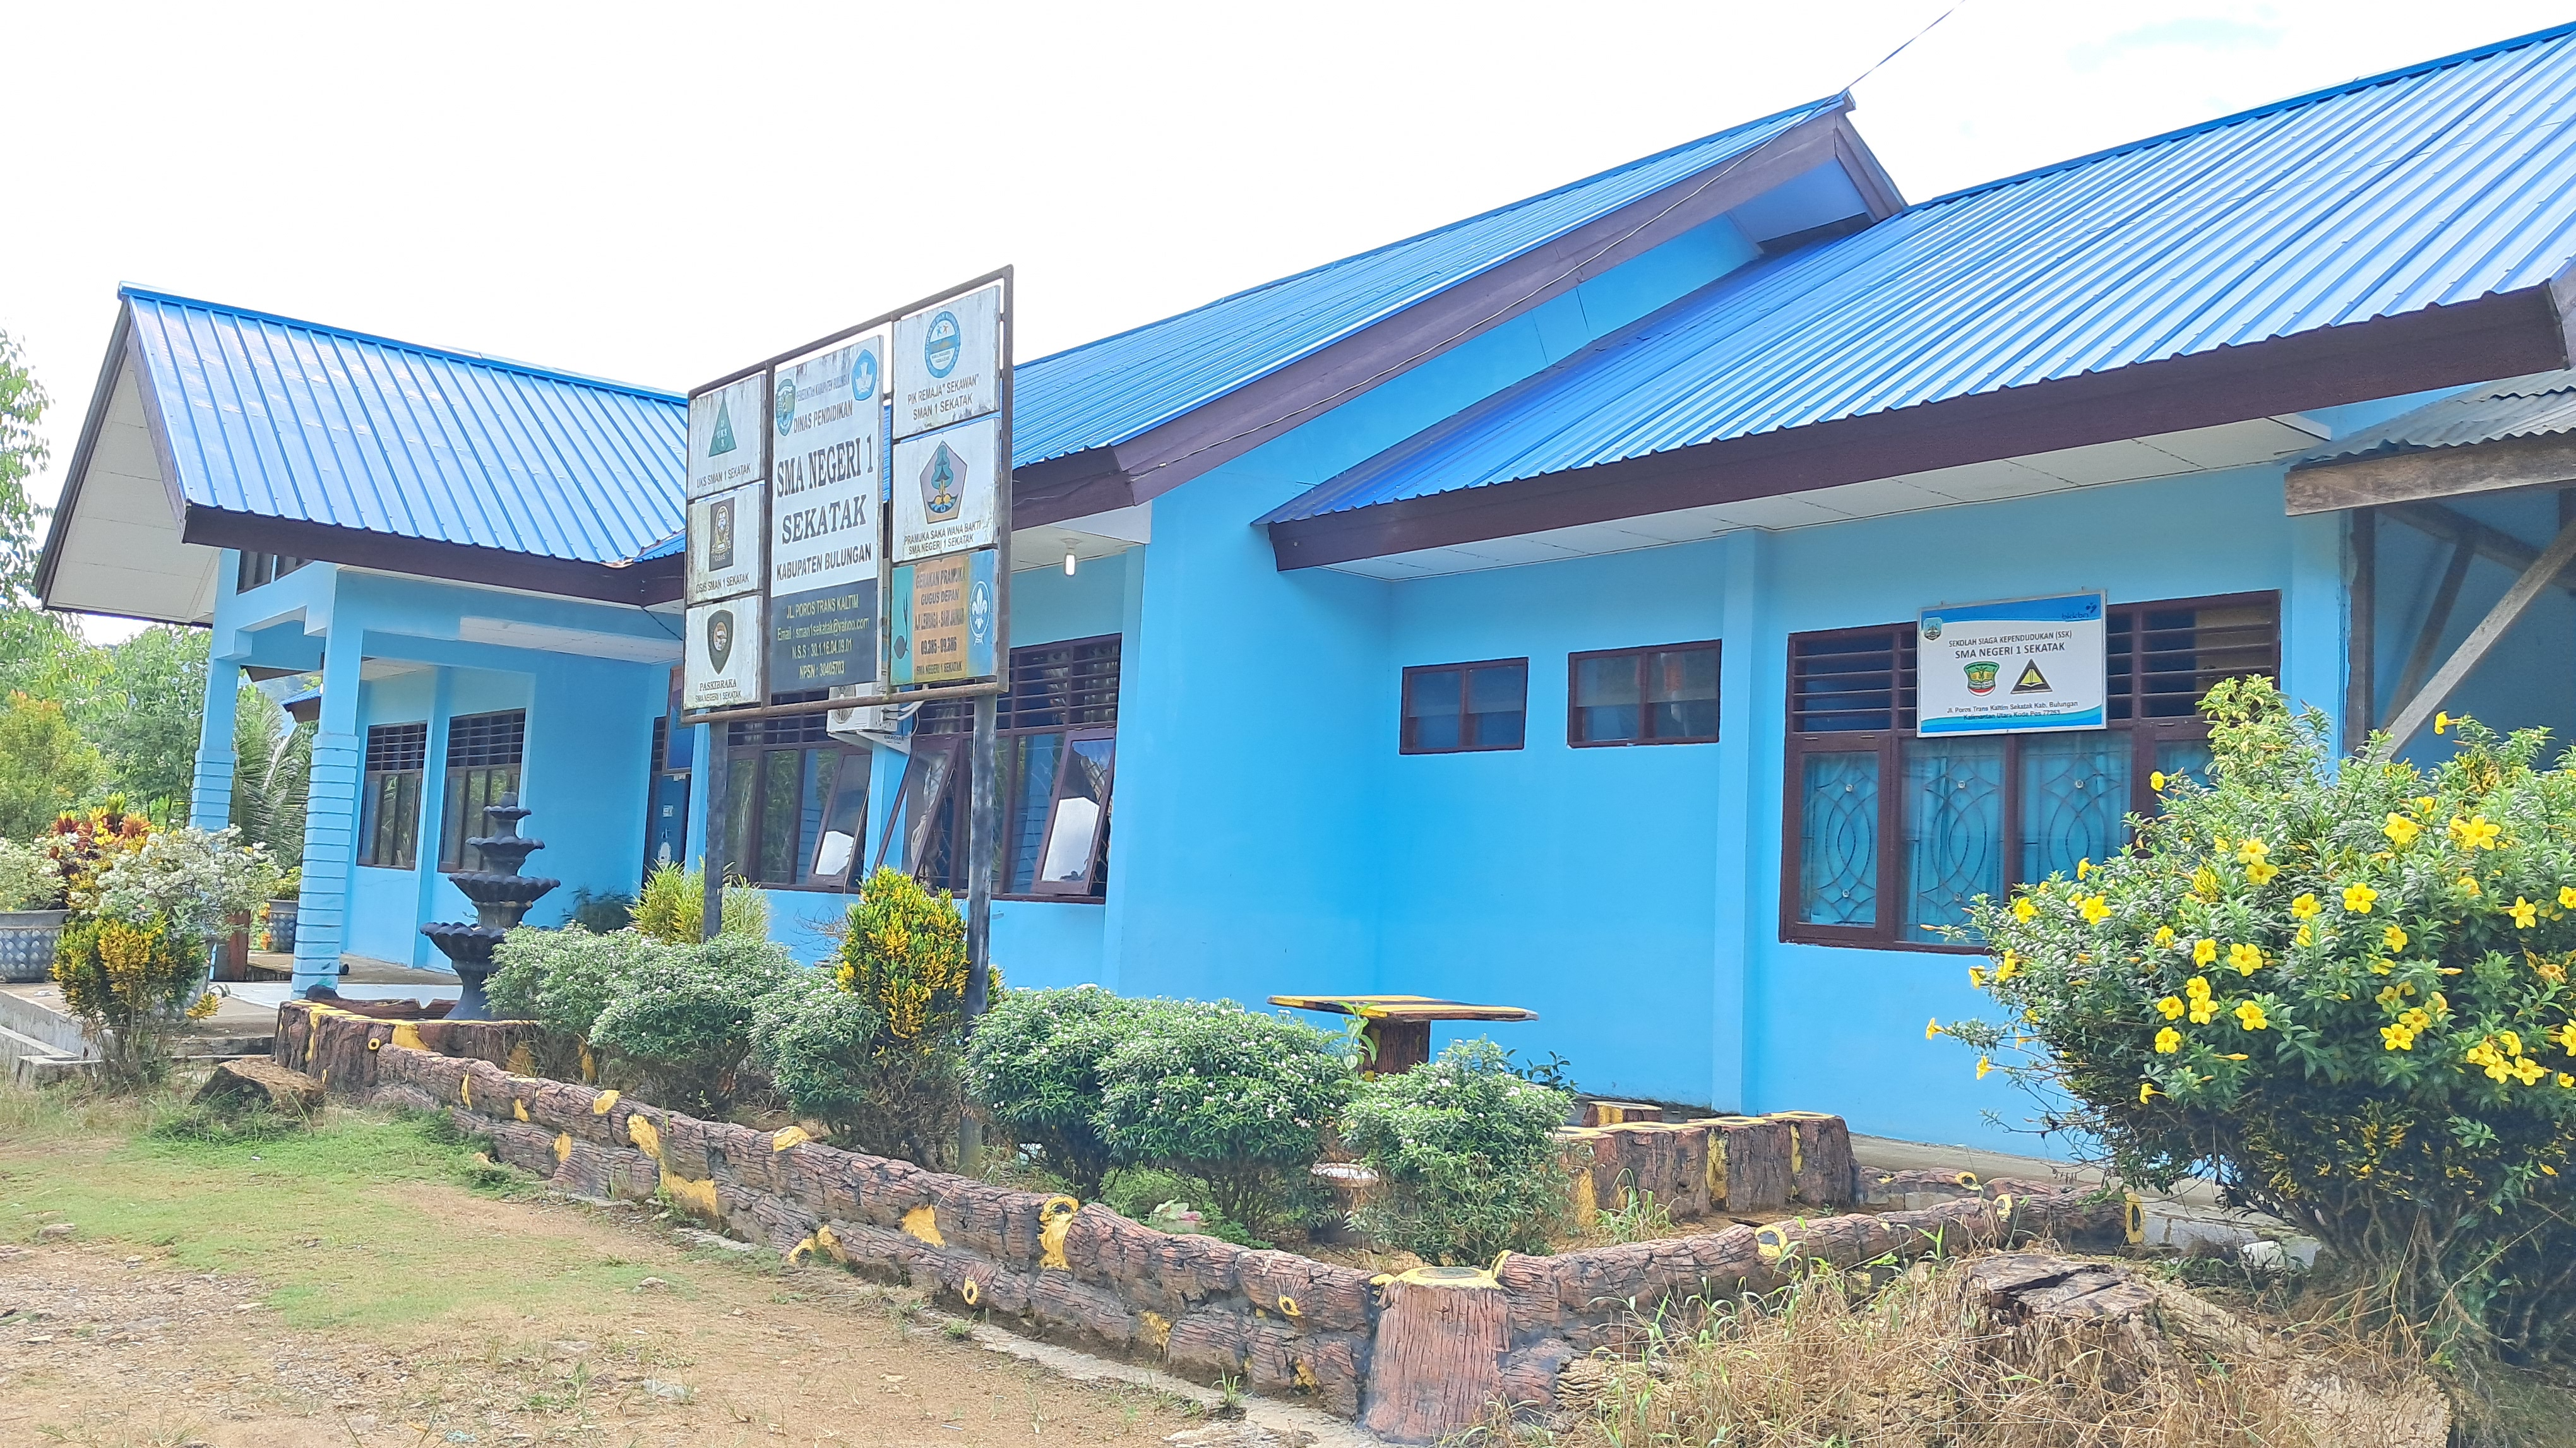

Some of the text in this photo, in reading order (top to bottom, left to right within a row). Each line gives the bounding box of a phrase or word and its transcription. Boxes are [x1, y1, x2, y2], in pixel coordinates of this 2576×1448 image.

[907, 393, 917, 405] PIK
[913, 393, 972, 420] SMAN 1 SEKATAK
[794, 399, 852, 433] DINAS PENDIDIKAN
[696, 475, 707, 488] UKS
[708, 470, 722, 484] SMAN
[728, 463, 751, 478] SEKATAK
[777, 434, 873, 497] SMA NEGERI 1
[782, 494, 866, 545] SEKATAK
[904, 520, 981, 545] PRAMUKA SAKA WANA BAKTI
[909, 546, 921, 555] SMA
[922, 540, 942, 552] NEGERI
[948, 533, 974, 547] SEKATAK
[777, 542, 871, 581] KABUPATEN BULUNGAN
[708, 578, 722, 590] SMAN
[726, 573, 749, 586] SEKATAK
[796, 601, 815, 617] POROS
[817, 598, 836, 613] TRANS
[837, 594, 859, 611] KALTIM
[921, 588, 959, 605] GUGUS DEPAN
[777, 626, 792, 641] Email
[796, 617, 869, 638] sman1sekatak@yahoo.com
[1948, 639, 1977, 647] SEKOLAH
[2000, 632, 2053, 643] KEPENDUDUKAN
[2055, 630, 2072, 640] (SSK)
[792, 644, 806, 659] N.S.S
[1955, 642, 2065, 659] SMA NEGERI 1 SEKATAK
[799, 663, 815, 679] NPSN
[700, 679, 736, 691] PASKIBRAKA
